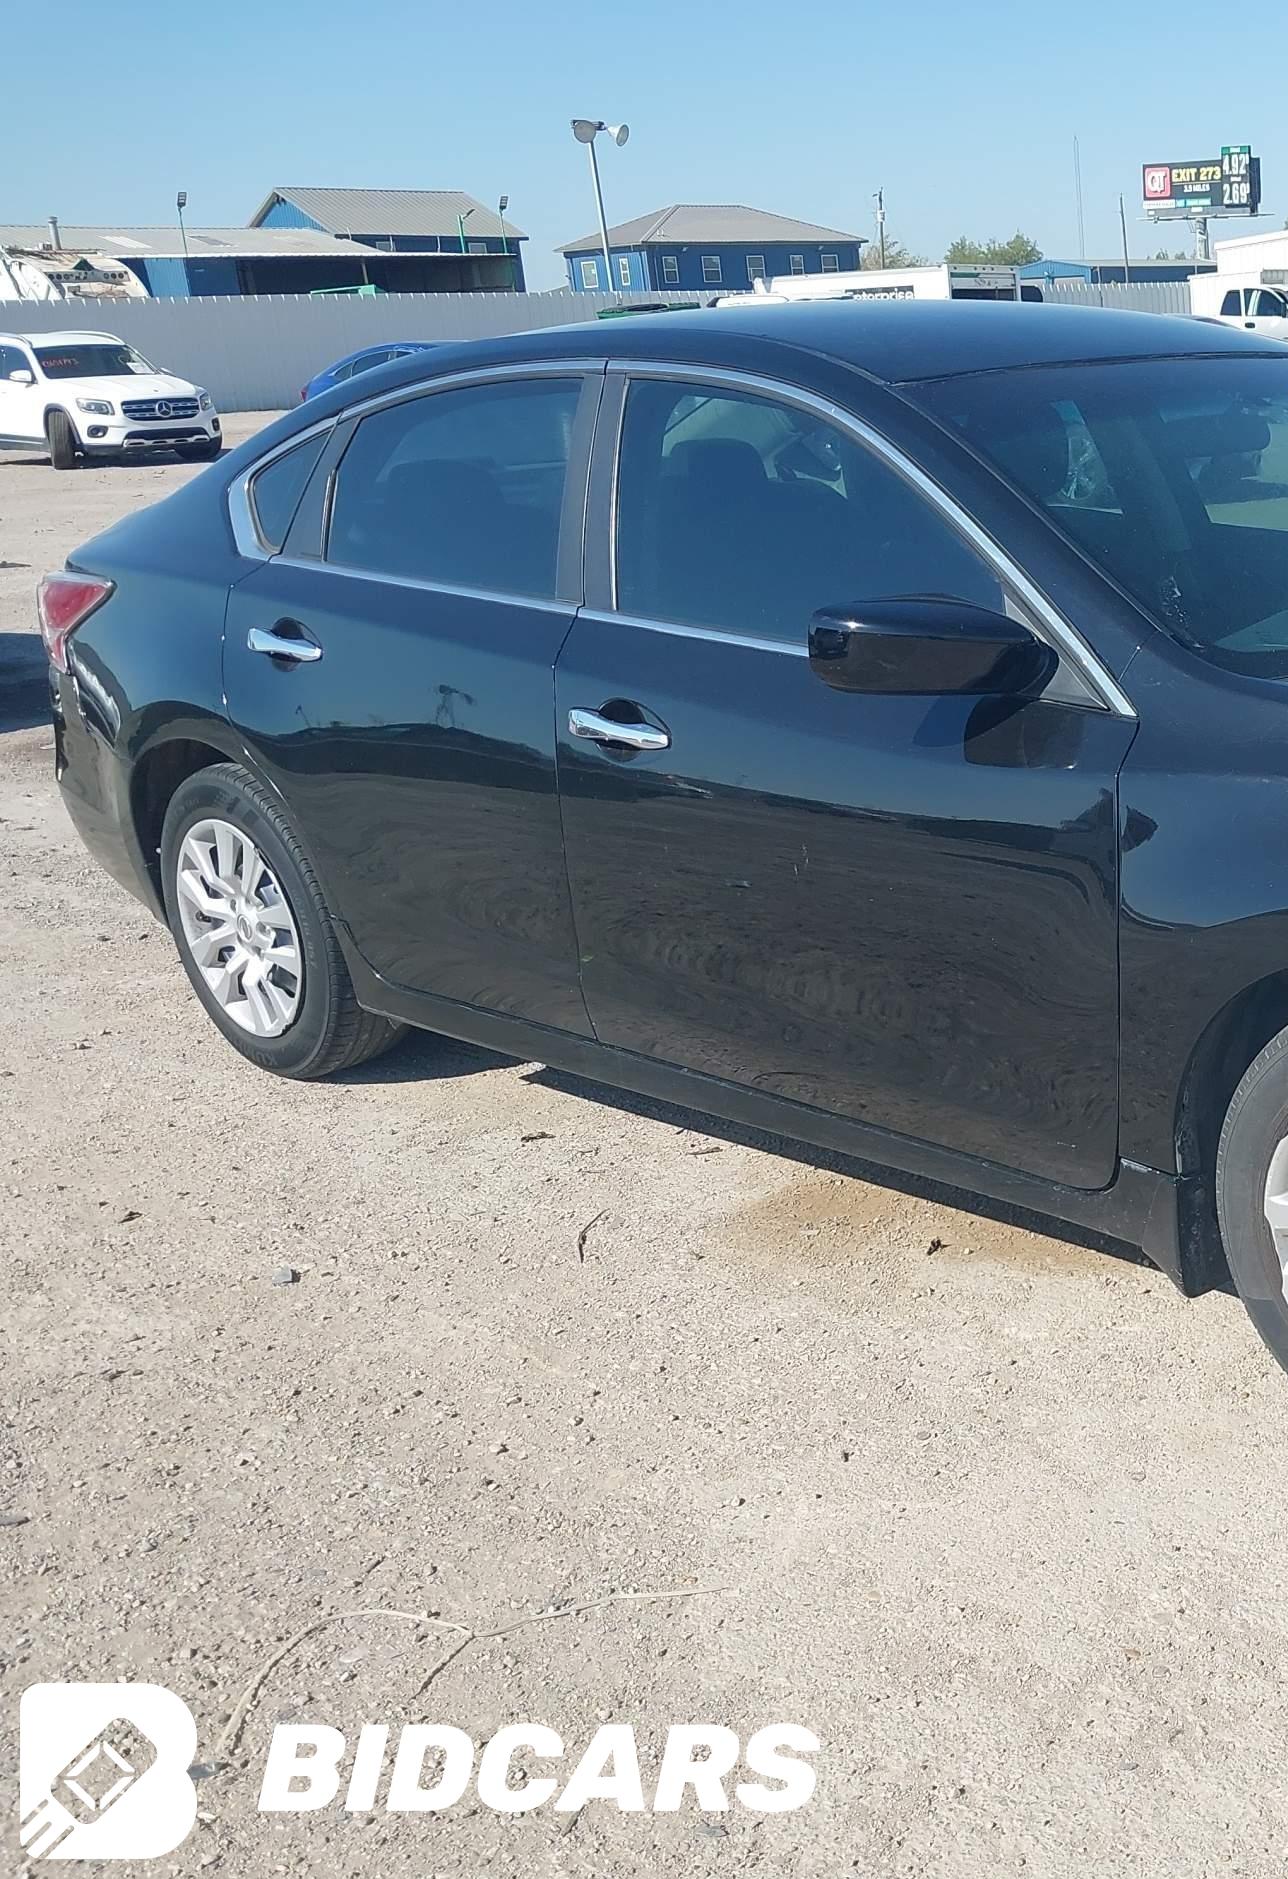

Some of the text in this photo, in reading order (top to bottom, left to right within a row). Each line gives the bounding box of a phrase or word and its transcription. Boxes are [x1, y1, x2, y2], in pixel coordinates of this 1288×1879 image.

[1171, 166, 1221, 182] EXIT 273
[1148, 171, 1167, 194] QT
[1193, 183, 1211, 192] MILES
